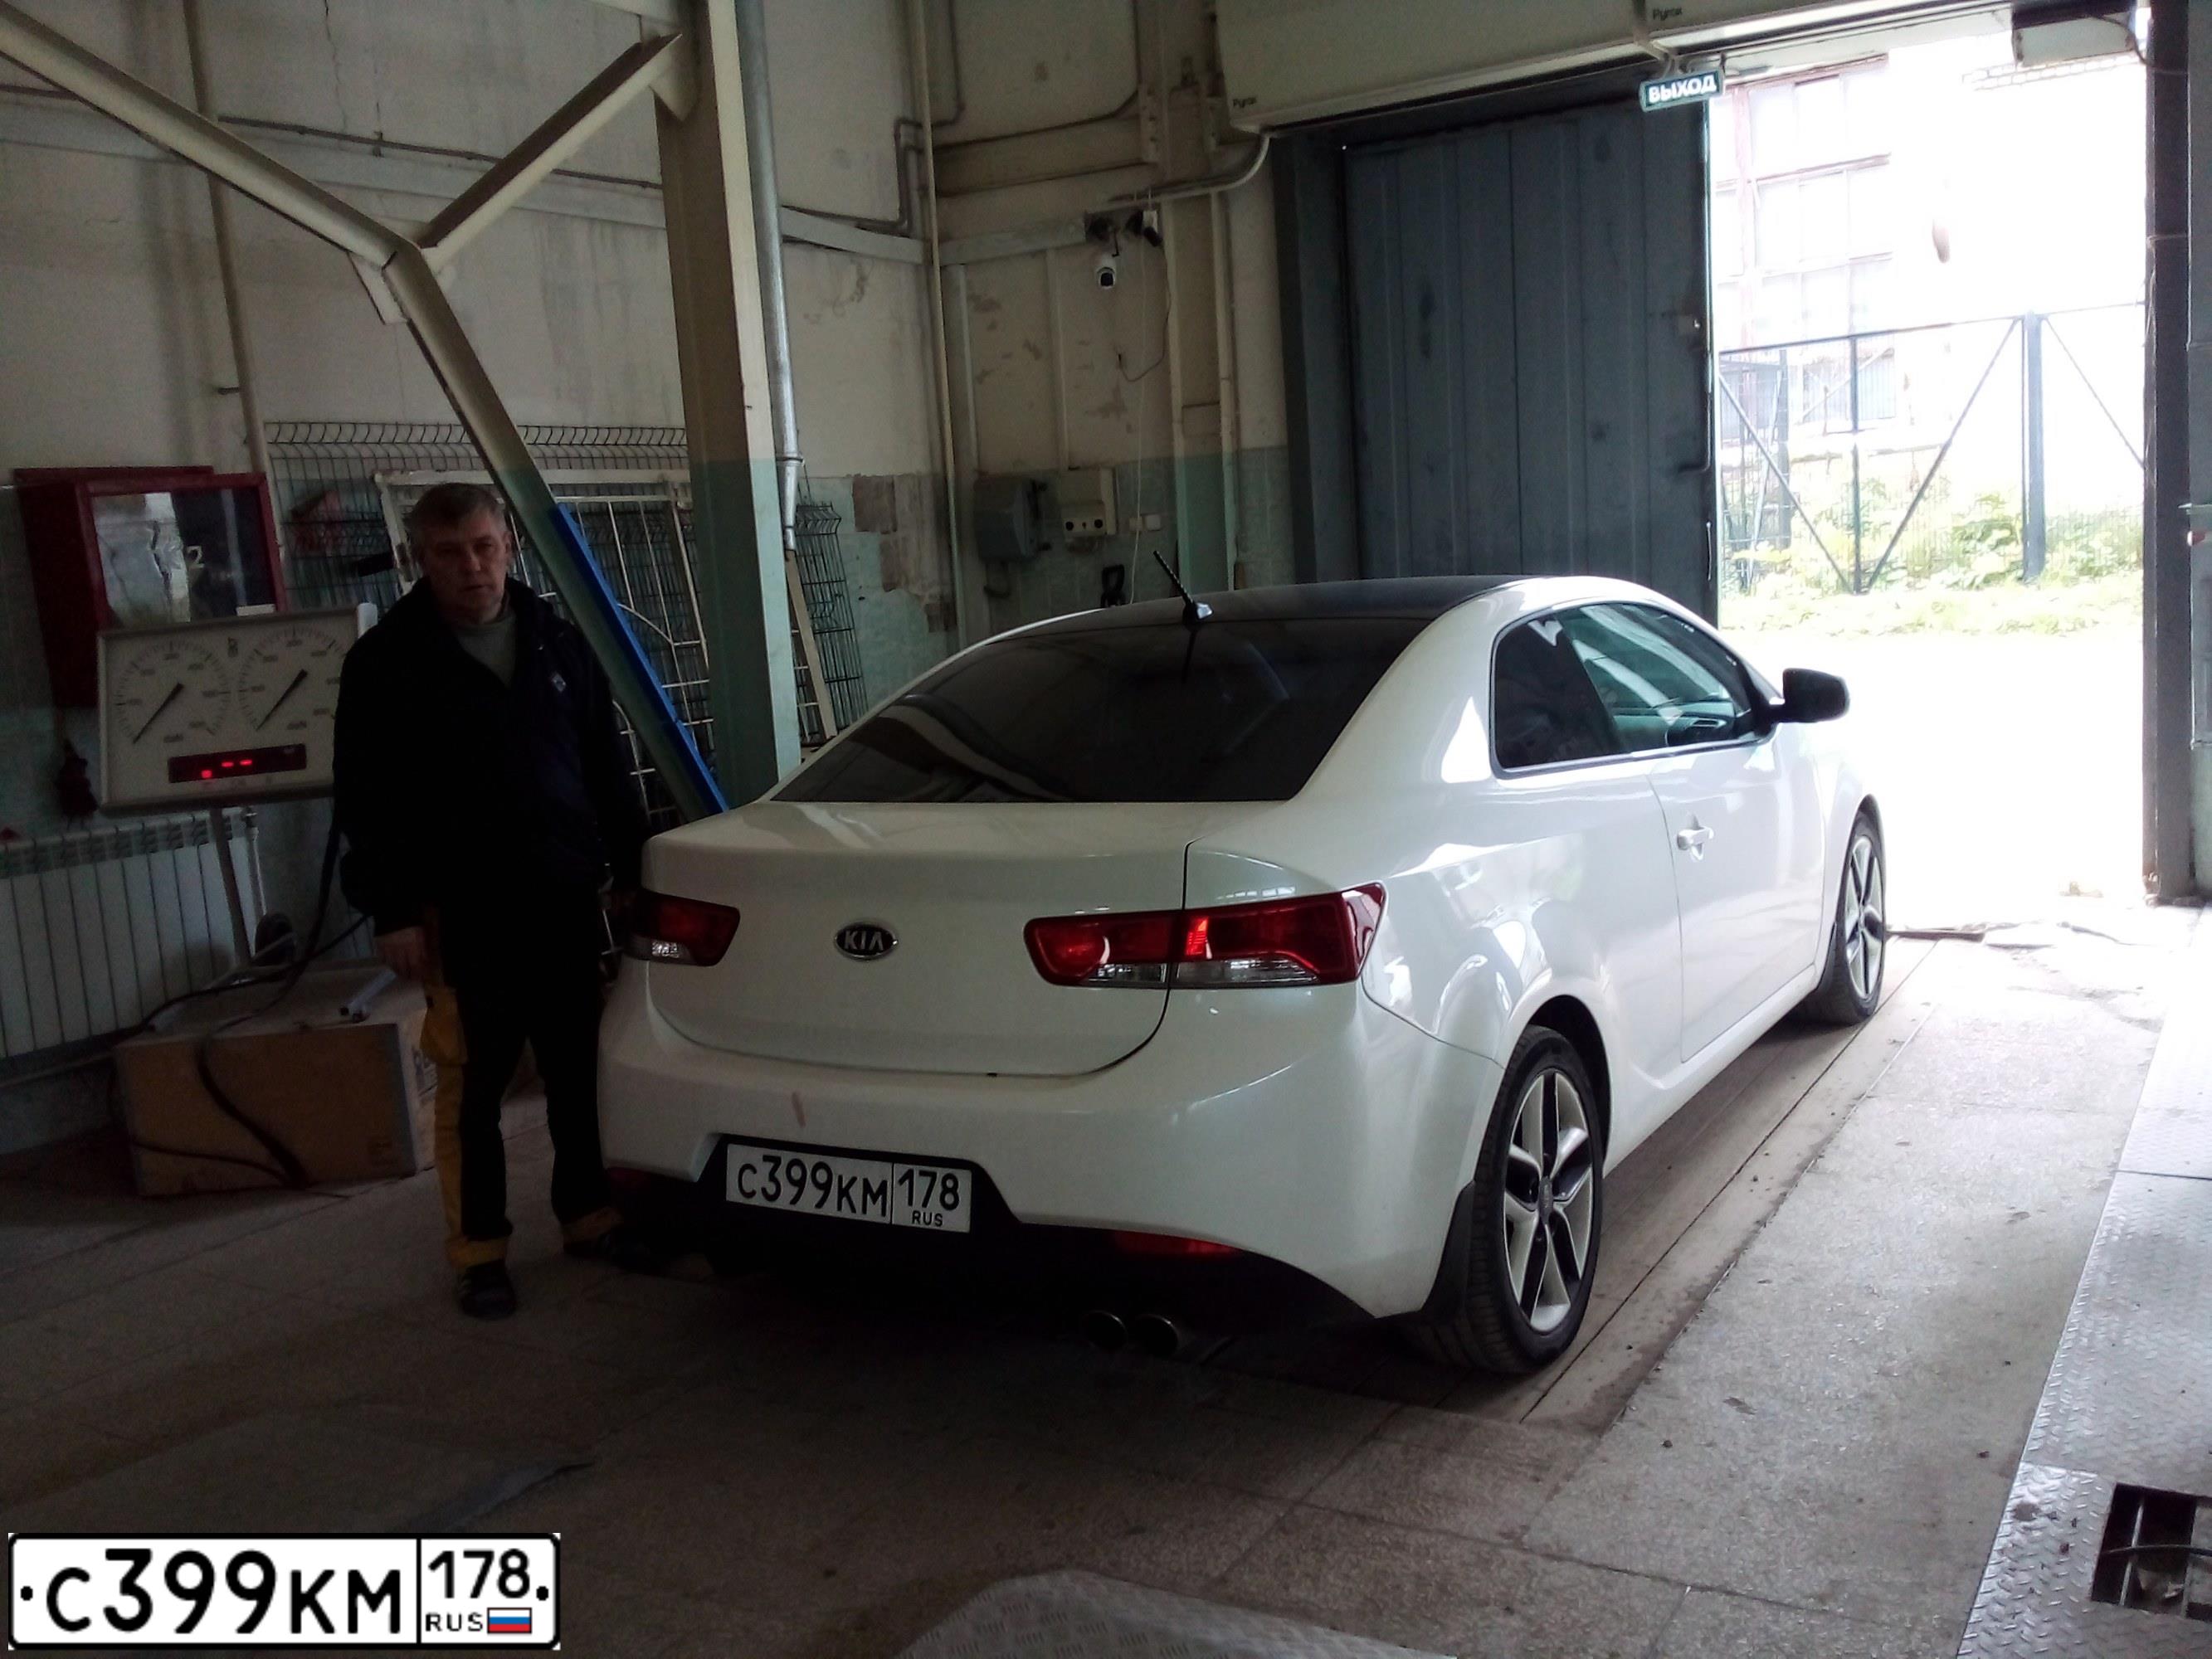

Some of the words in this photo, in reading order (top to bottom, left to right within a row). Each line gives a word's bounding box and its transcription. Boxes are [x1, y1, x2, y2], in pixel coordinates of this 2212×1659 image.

[1648, 74, 1717, 104] ВЫХОД
[845, 930, 884, 951] KIA
[898, 1168, 960, 1212] 178
[912, 1209, 943, 1228] RUS
